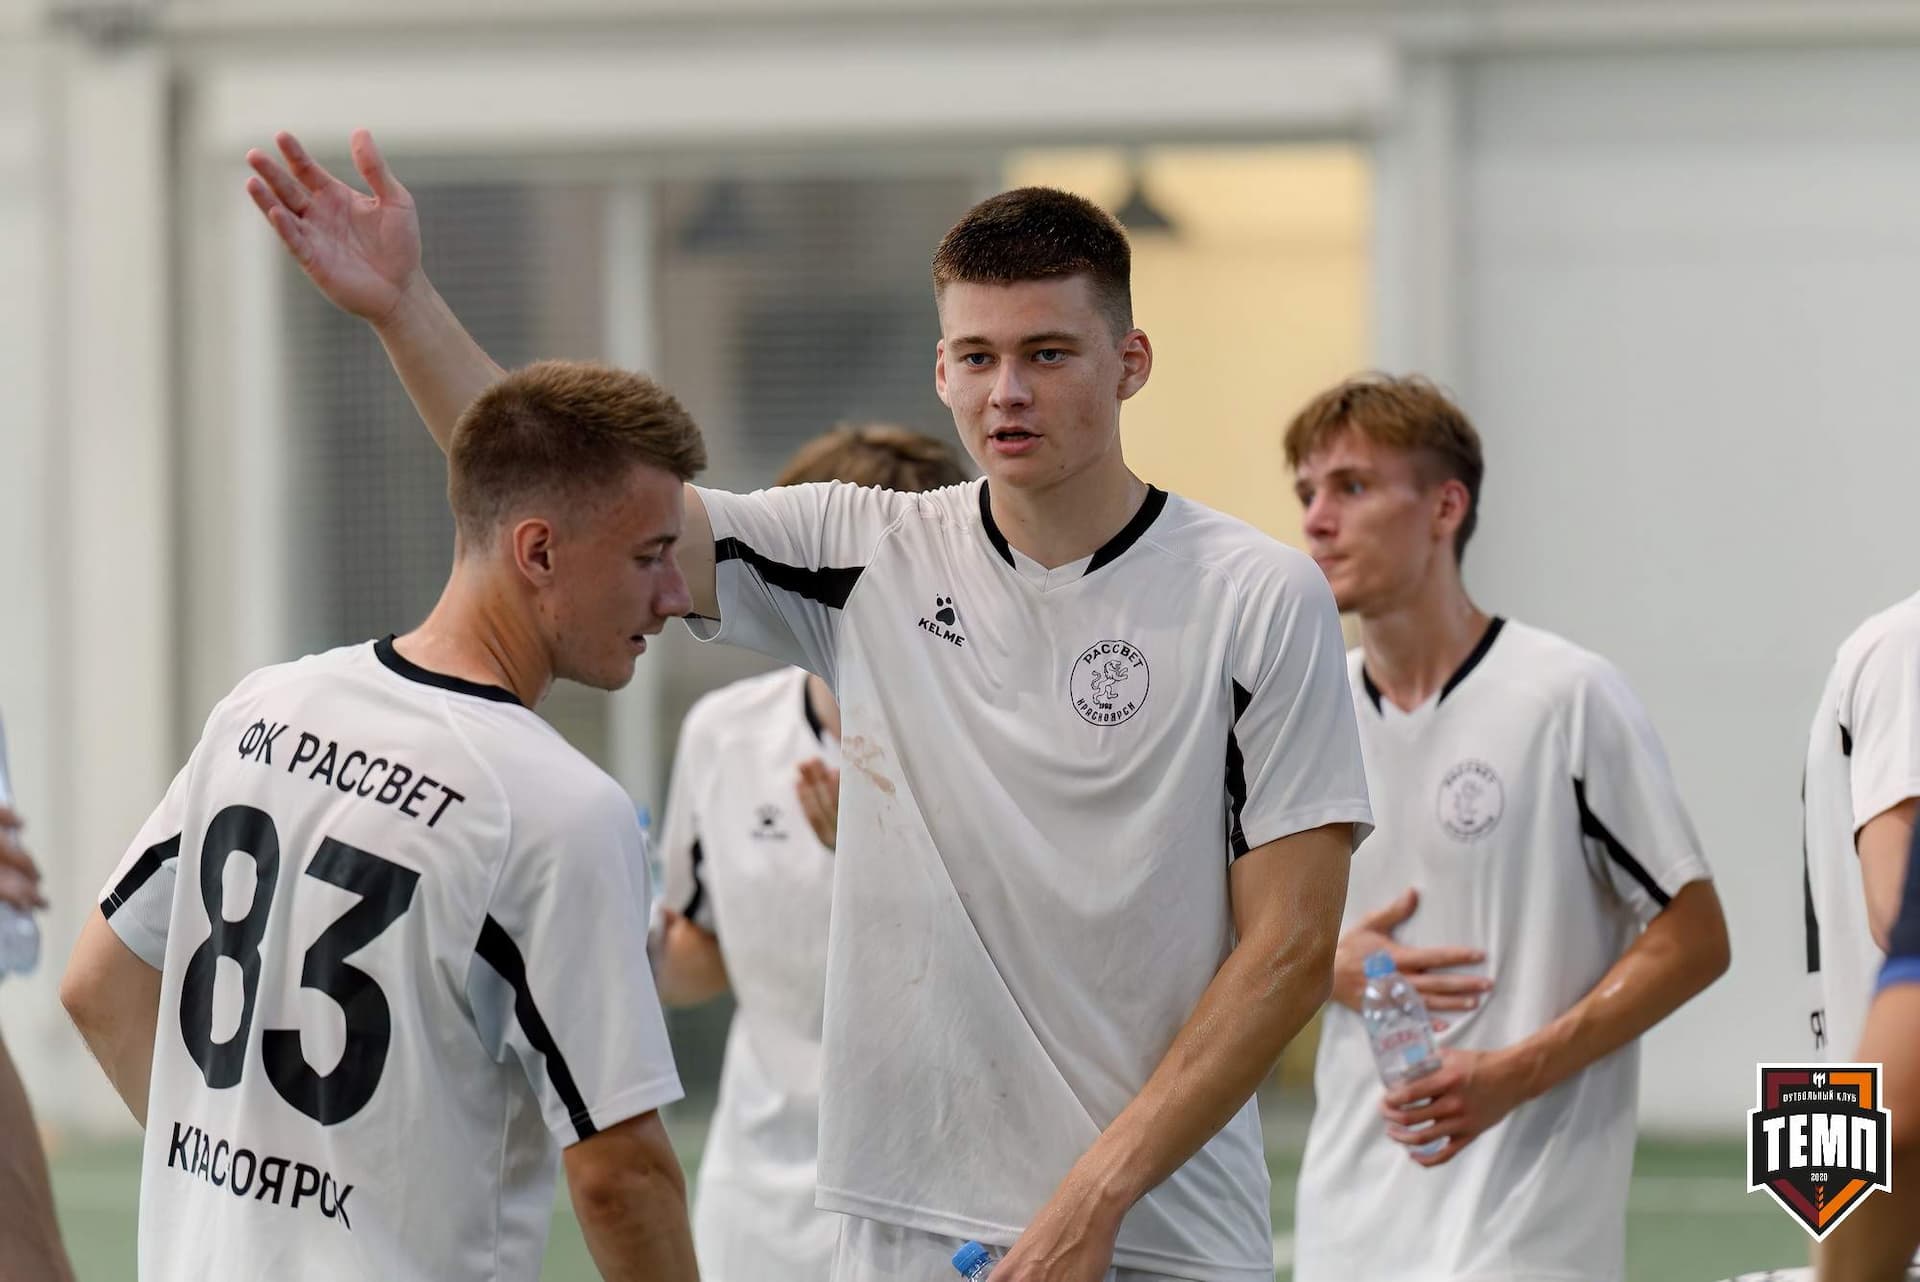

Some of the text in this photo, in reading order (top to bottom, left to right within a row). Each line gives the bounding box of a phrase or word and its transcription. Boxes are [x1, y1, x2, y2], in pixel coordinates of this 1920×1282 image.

[918, 617, 965, 647] KELME
[1083, 644, 1143, 668] РАССВЕТ
[238, 718, 465, 828] ФК РАССВЕТ
[179, 804, 421, 1126] 83
